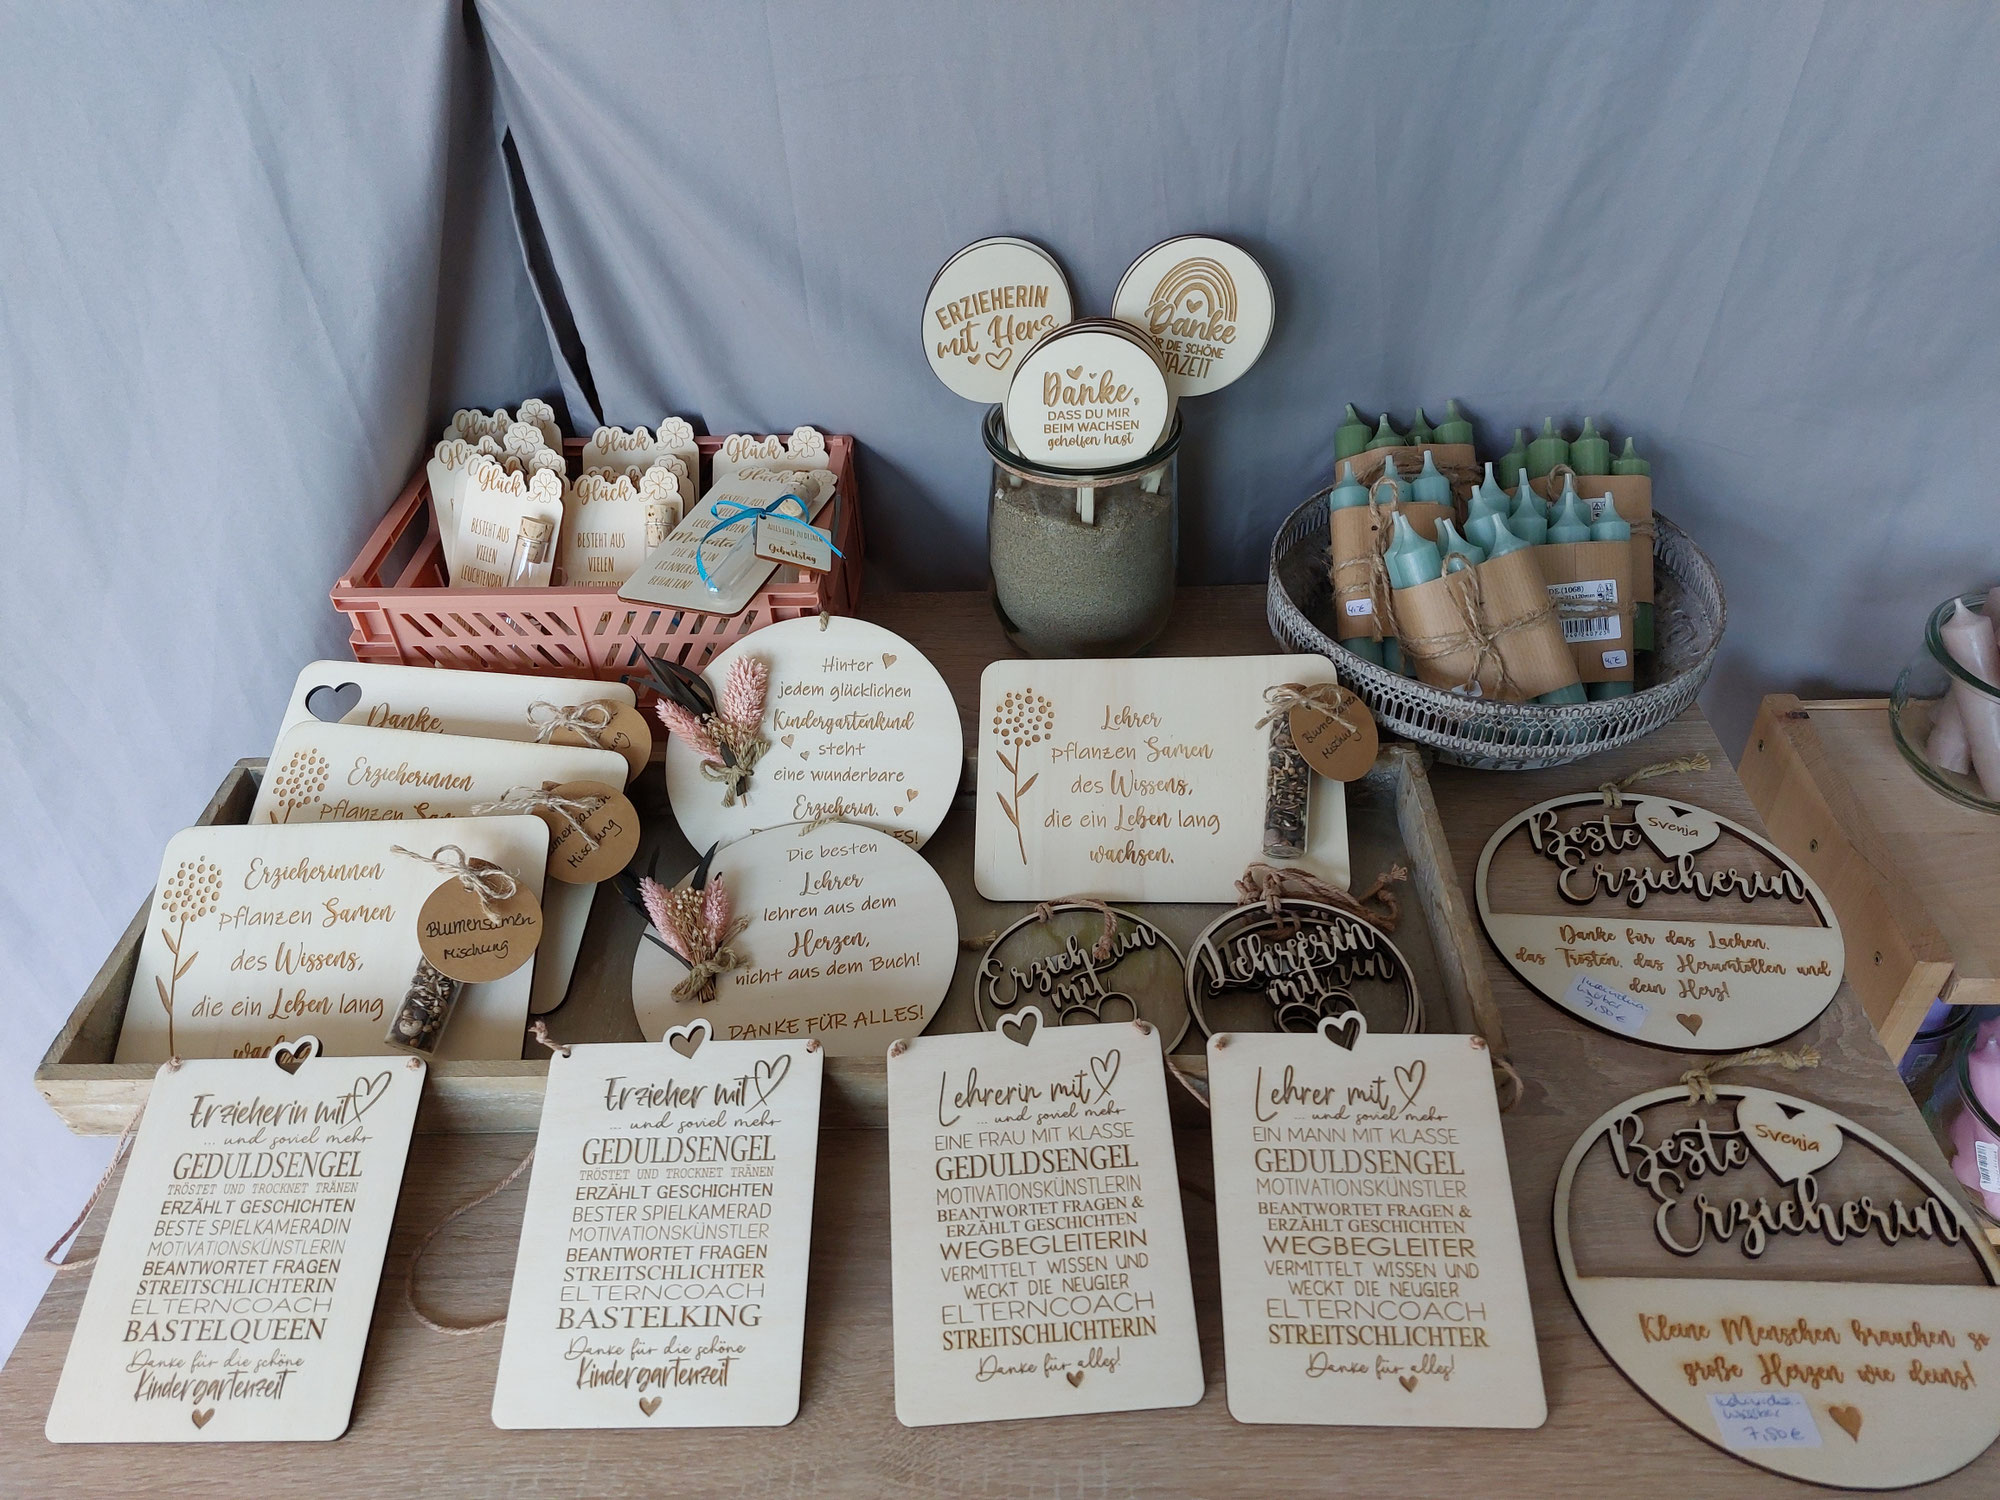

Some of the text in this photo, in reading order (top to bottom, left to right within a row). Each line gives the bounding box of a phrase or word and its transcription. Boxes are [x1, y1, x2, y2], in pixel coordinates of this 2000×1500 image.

[935, 285, 1048, 330] ERZIEHERIN
[1145, 300, 1236, 344] Danke
[937, 314, 1059, 358] mit Herz
[1167, 339, 1183, 352] DIE
[1185, 343, 1225, 359] SCHÖNE
[1161, 351, 1213, 378] TAZEIT
[1043, 369, 1140, 407] Danke,
[1044, 420, 1139, 434] BEIM WACHSEN
[1048, 408, 1130, 421] DASS DU MIR
[596, 430, 649, 455] Glück
[726, 437, 781, 463] Glück
[1048, 433, 1134, 450] geholfen hast
[479, 464, 522, 497] Glück
[576, 479, 633, 505] Glück
[471, 518, 510, 544] BESTEHT AUS
[577, 533, 626, 548] BESTEHT AUS
[476, 544, 498, 565] VIELEN
[588, 557, 614, 572] VIELEN
[822, 656, 873, 673] Hinter
[777, 681, 911, 702] jedem glücklichen
[773, 709, 914, 734] Kindergartenkind
[1101, 705, 1162, 730] Lehrer
[818, 742, 865, 757] steht
[1051, 736, 1214, 762] pflanzen Samen
[347, 757, 476, 792] Erzieherinnen
[773, 767, 905, 783] eine wunderbare
[1071, 769, 1193, 797] des Wissens,
[320, 800, 403, 822] pflanzen
[793, 795, 879, 820] Erzieherin.
[1045, 804, 1221, 835] die ein Leben lang
[1529, 811, 1642, 854] Beste
[1649, 817, 1699, 838] Svenja
[787, 842, 877, 862] Die besten
[1089, 840, 1175, 864] wachsen.
[244, 857, 385, 890] Erzieherinnen
[799, 871, 864, 896] Lehrer
[1558, 846, 1808, 907] Erzieherin
[219, 897, 396, 931] pflanzen Samen
[763, 896, 896, 921] lehren aus dem
[788, 929, 870, 958] Herzen,
[1560, 925, 1616, 944] Danke
[1626, 929, 1654, 944] für
[1666, 930, 1695, 948] das
[230, 942, 364, 976] des Wissens,
[736, 952, 920, 986] nicht aus dem Buch!
[1516, 948, 1545, 965] das
[1633, 952, 1664, 970] das
[1677, 954, 1786, 975] Herumtollen
[1797, 964, 1831, 977] und
[1630, 978, 1666, 996] dein
[1679, 979, 1729, 1001] Herz!
[191, 989, 385, 1021] die ein Leben lang
[729, 1005, 924, 1041] DANKE FÜR ALLES!
[605, 1075, 761, 1112] Erzieher mit
[939, 1067, 1091, 1127] Lehrerin mit
[1255, 1065, 1389, 1122] Lehrer mit
[191, 1092, 362, 1129] Erzieherin mit
[935, 1122, 1135, 1151] EINE FRAU MIT KLASSE
[1606, 1113, 1750, 1177] Beste
[1756, 1124, 1820, 1152] Svenja
[582, 1135, 776, 1165] GEDULDSENGEL
[935, 1143, 1139, 1181] GEDULDSENGEL
[1255, 1148, 1465, 1175] GEDULDSENGEL
[173, 1151, 362, 1180] GEDULDSENGEL
[168, 1180, 358, 1196] TRÖSTET UND TROCKNET TRÄNEN
[936, 1174, 1141, 1206] MOTIVATIONSKÜNSTLERIN
[161, 1198, 356, 1215] ERZÄHLT GESCHICHTEN
[573, 1202, 772, 1222] BESTER SPIELKAMERAD
[1654, 1168, 1964, 1258] Erzieherin
[154, 1218, 351, 1237] BESTE SPIELKAMERADIN
[569, 1223, 769, 1242] MOTIVATIONSKÜNSTLER
[147, 1239, 345, 1257] MOTIVATIONSKÜNSTLERIN
[940, 1229, 1148, 1261] WEGBEGLEITERIN
[142, 1258, 341, 1276] BEANTWORTET FRAGEN
[564, 1263, 766, 1282] STREITSCHLICHTER
[136, 1278, 336, 1296] STREITSCHLICHTERIN
[131, 1297, 332, 1315] ELTERNCOACH
[556, 1304, 761, 1330] BASTELKING
[942, 1290, 1155, 1325] ELTERNCOACH
[122, 1318, 327, 1344] BASTELQUEEN
[943, 1316, 1157, 1351] STREITSCHLICHTERIN
[1269, 1324, 1490, 1347] STREITSCHLICHTER
[1639, 1313, 1990, 1351] Kleine Menschen brauchen so
[1684, 1353, 1977, 1391] große Herzen wie deins!
[134, 1370, 298, 1405] Kindergartenzeit
